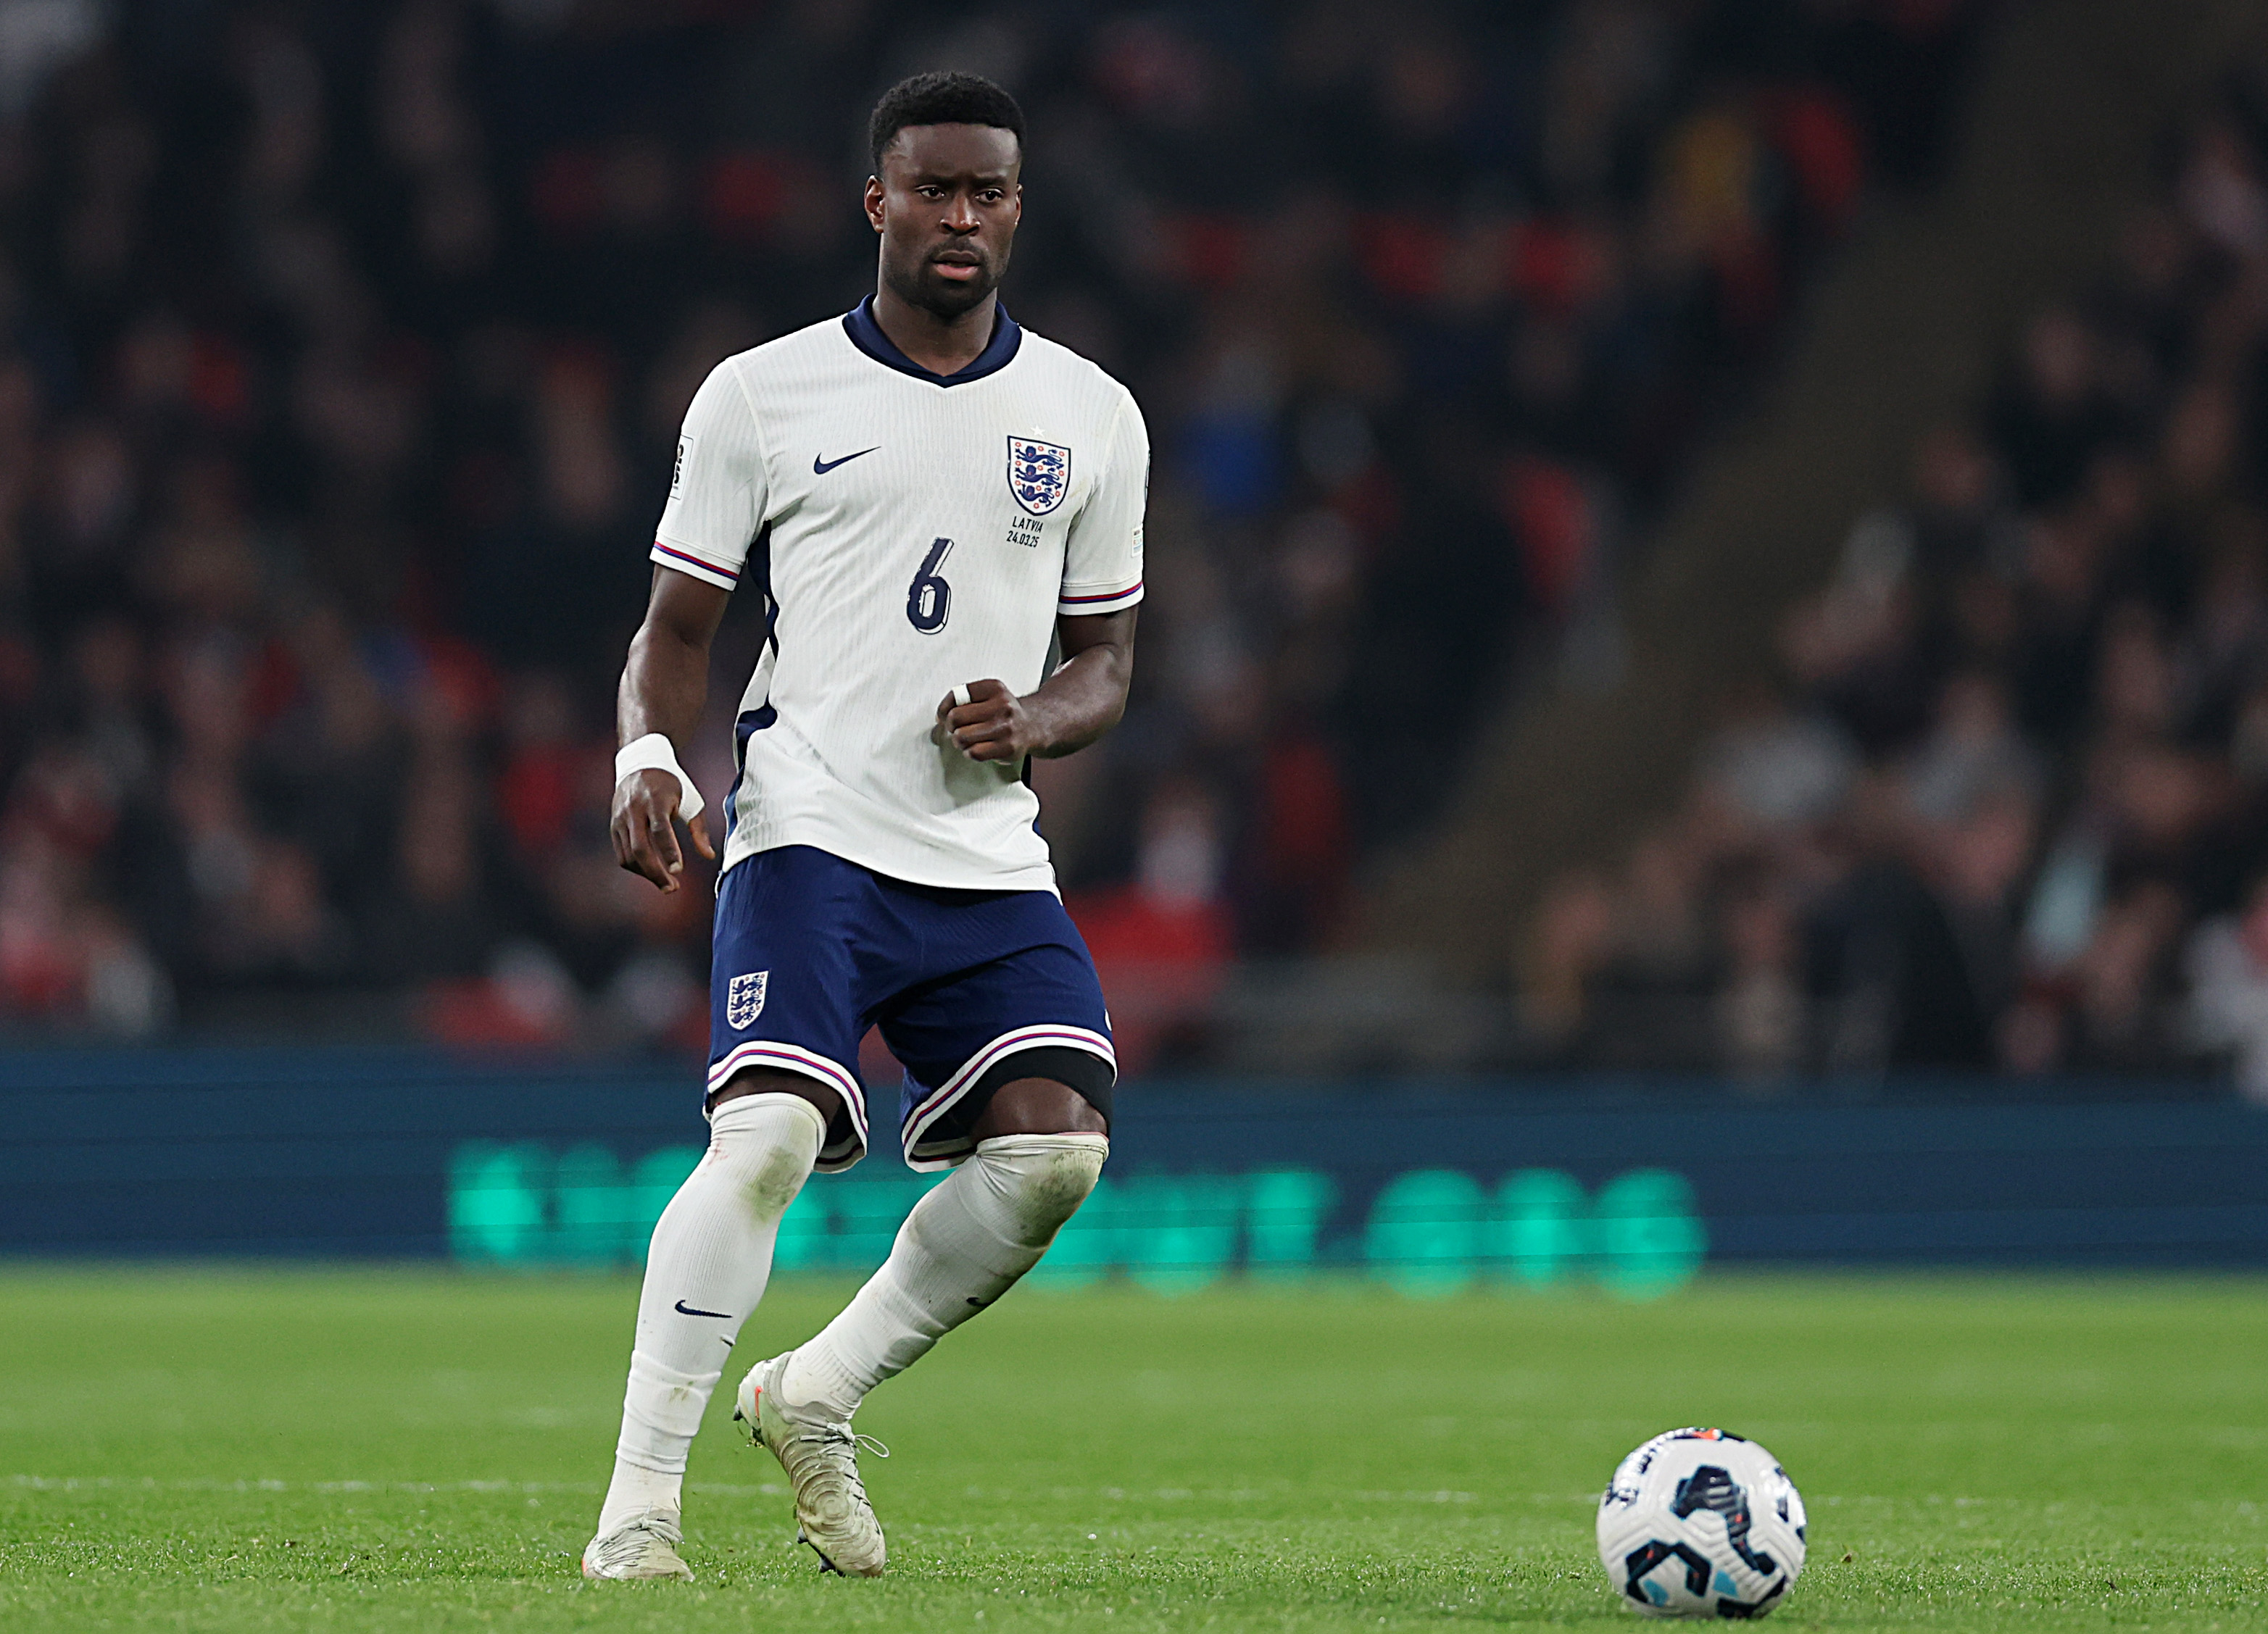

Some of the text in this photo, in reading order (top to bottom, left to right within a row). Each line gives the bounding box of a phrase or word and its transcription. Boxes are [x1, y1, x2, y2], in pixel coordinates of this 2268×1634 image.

[1012, 515, 1044, 533] LATVIA
[1006, 530, 1040, 548] 24.03.25
[907, 536, 955, 635] 6
